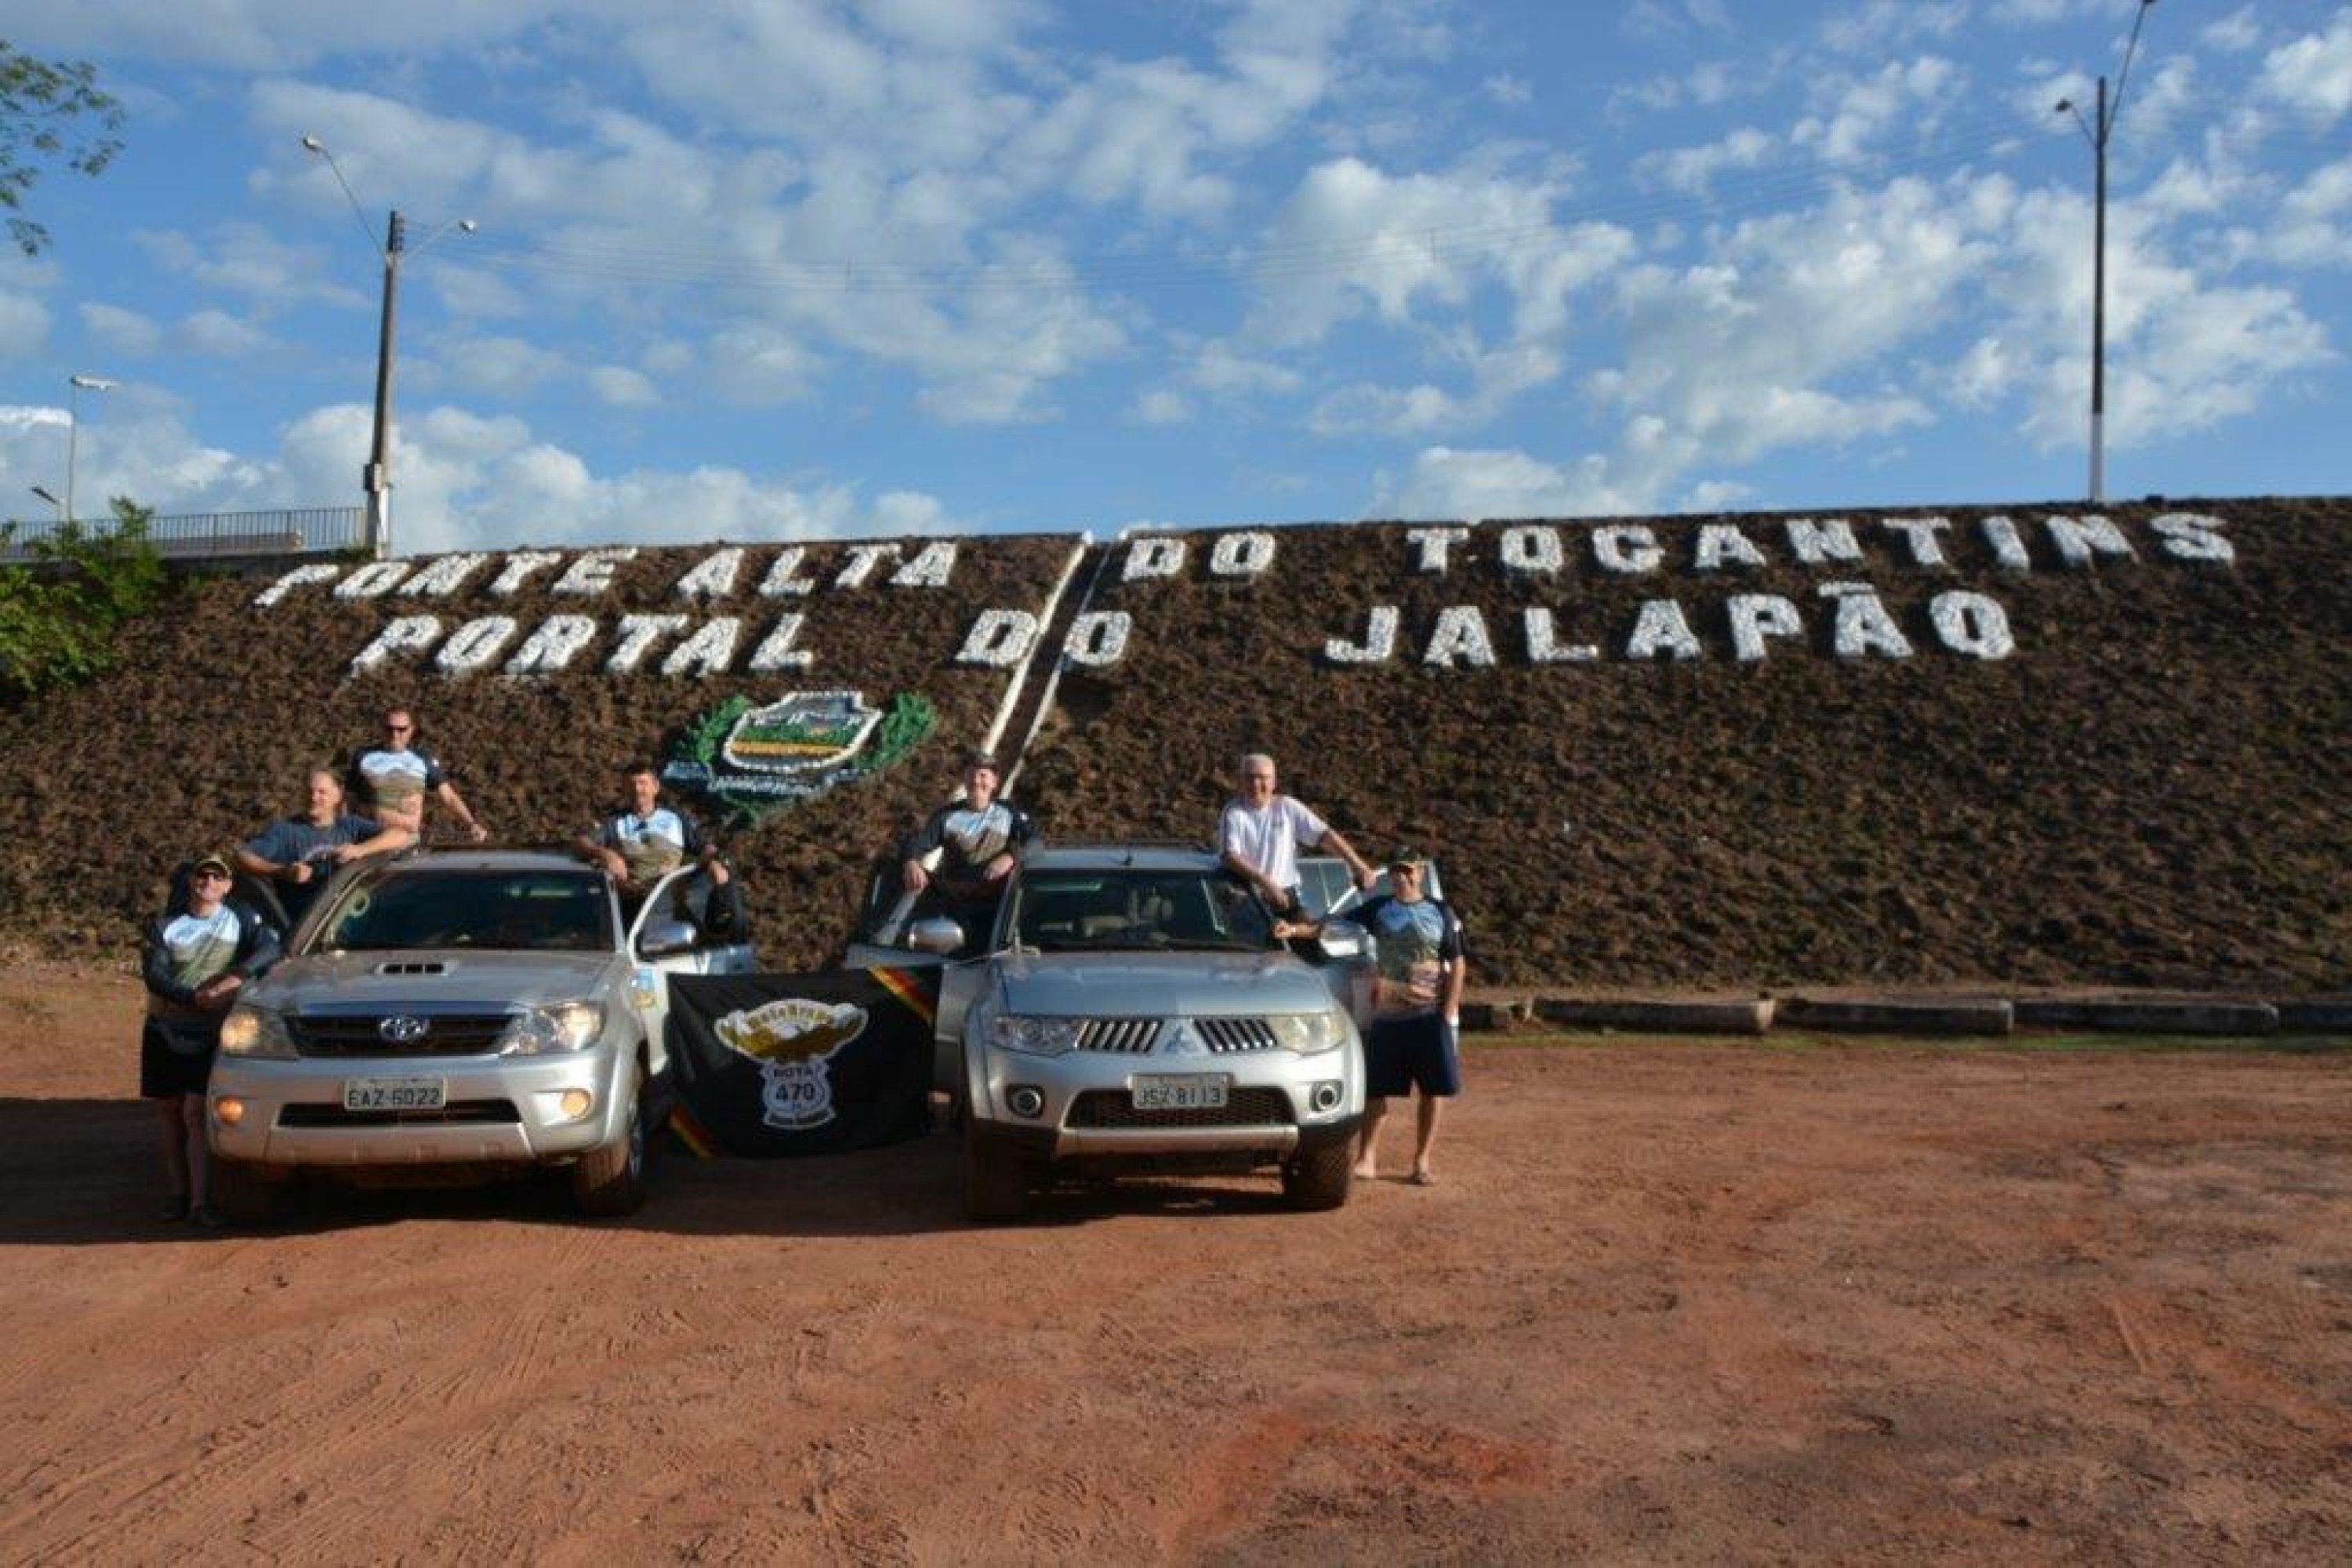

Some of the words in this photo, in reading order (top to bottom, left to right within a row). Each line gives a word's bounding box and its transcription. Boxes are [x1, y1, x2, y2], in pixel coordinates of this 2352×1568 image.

[676, 543, 956, 597] ALTA
[1123, 535, 1276, 581] DO
[1408, 513, 2235, 572] TOCANTINS
[350, 614, 814, 679] PORTAL
[954, 608, 1132, 666] DO
[1325, 581, 2014, 665] JALAPÃO
[776, 1081, 815, 1101] 470
